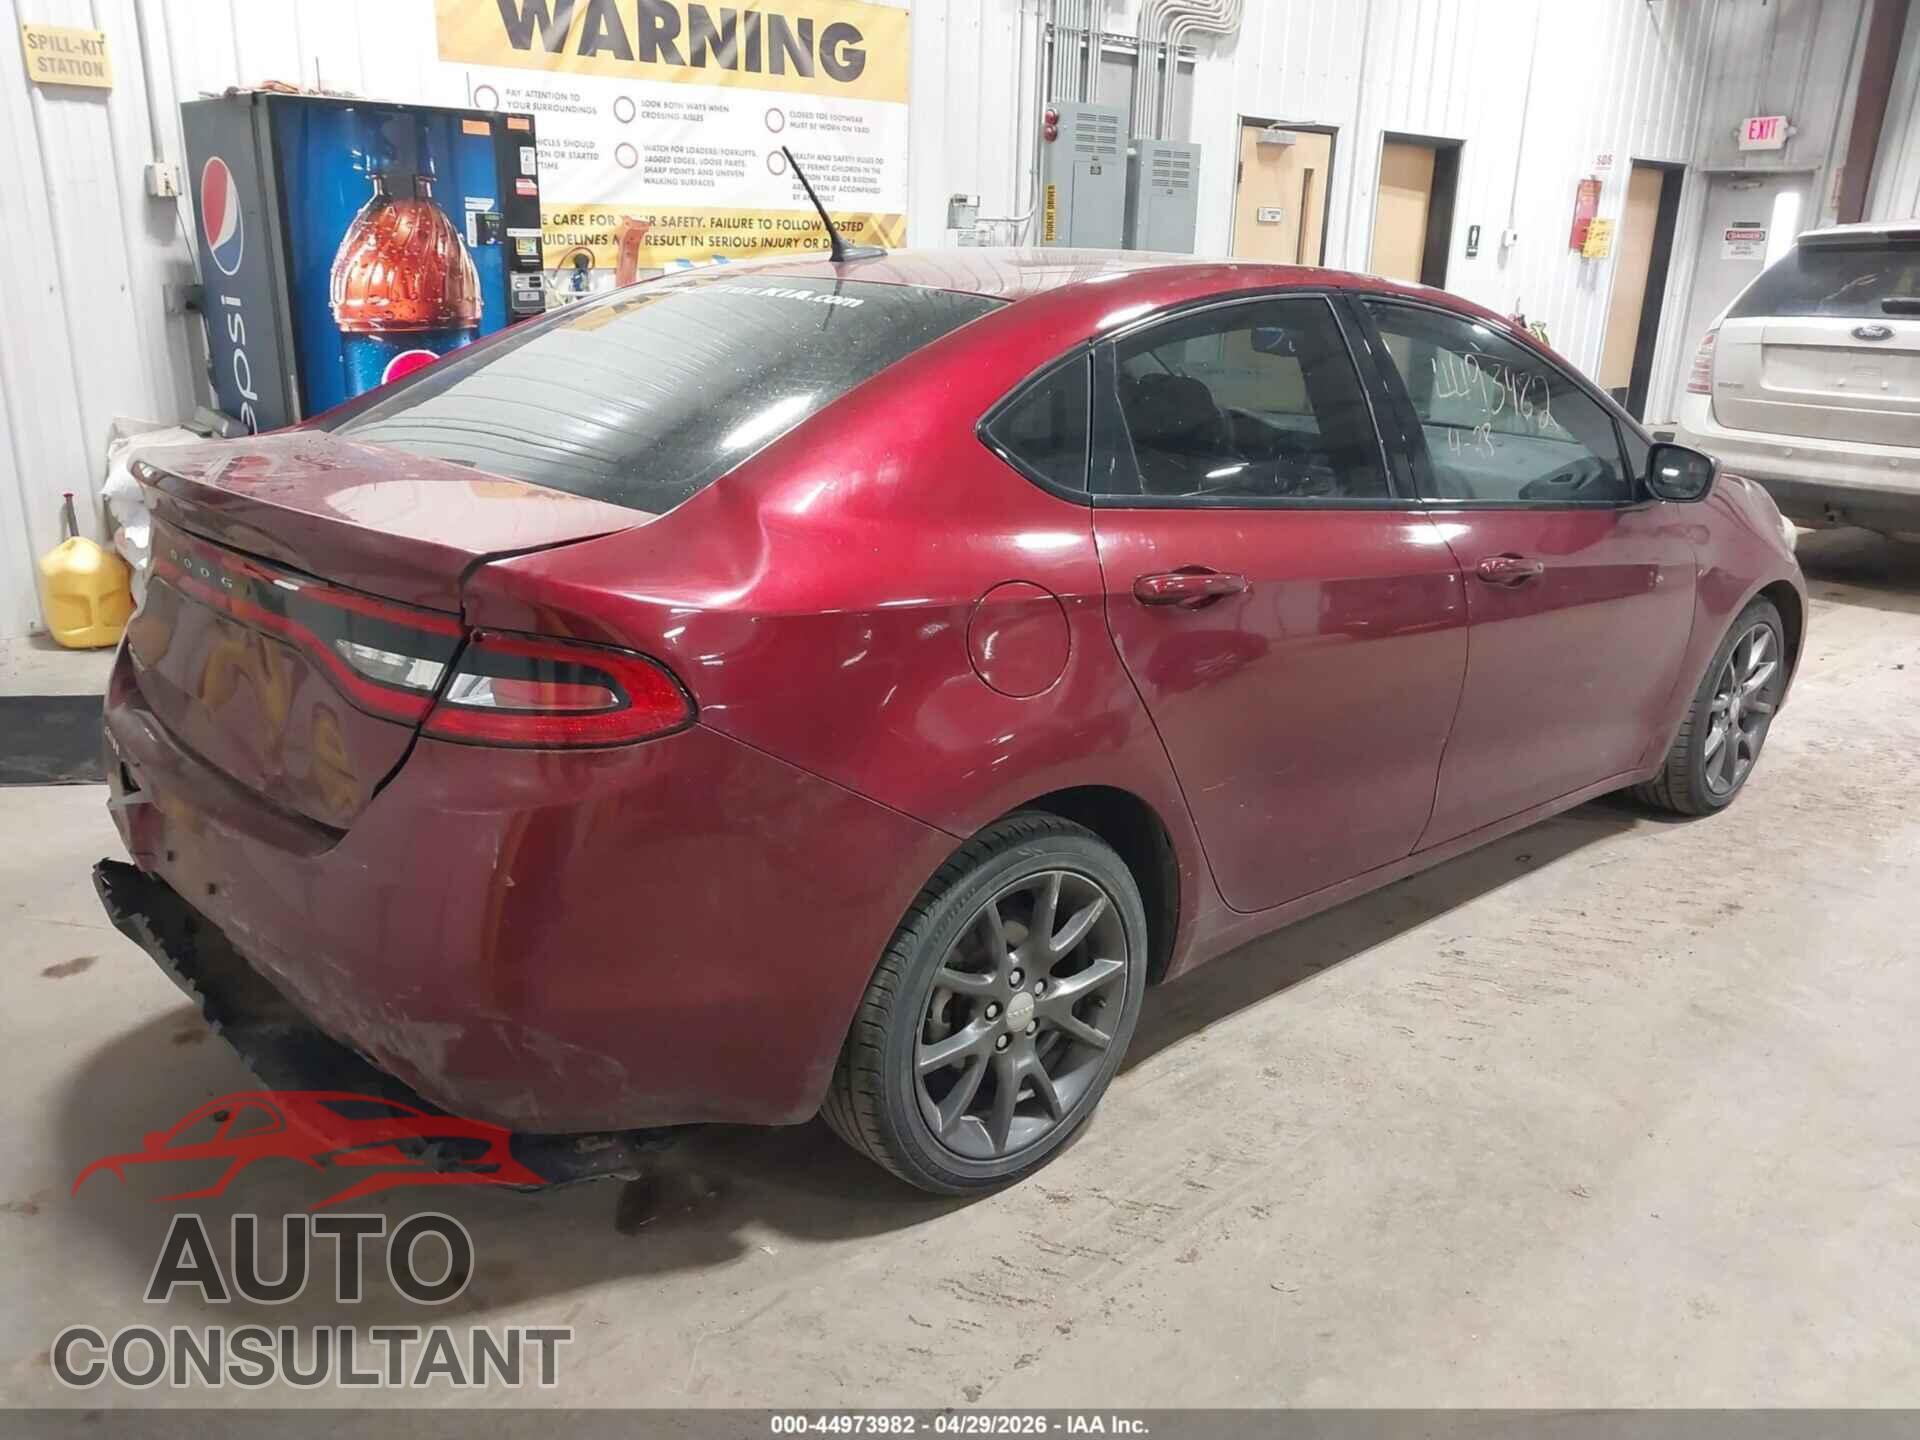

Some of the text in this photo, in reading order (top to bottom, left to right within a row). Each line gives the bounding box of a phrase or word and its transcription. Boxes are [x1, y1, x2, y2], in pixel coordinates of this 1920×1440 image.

[27, 32, 105, 56] SPILL-KIT
[499, 0, 867, 82] WARNING
[38, 56, 105, 77] STATION
[526, 90, 568, 101] ATTENTION
[570, 94, 580, 102] TO
[507, 101, 598, 115] YOUR SURROUNDINGS
[641, 99, 661, 108] LOOK
[708, 104, 730, 113] WHEN
[641, 111, 680, 120] CROSSING
[1748, 118, 1779, 141] EXIT
[563, 139, 596, 149] SHOULD
[670, 145, 684, 153] FOR
[554, 151, 566, 160] OR
[568, 152, 600, 161] STARTED
[669, 167, 695, 176] POINTS
[697, 168, 714, 177] AND
[643, 177, 716, 188] WALKING SURFACES
[553, 214, 584, 226] CARE
[590, 214, 616, 226] FOR
[661, 216, 706, 228] SAFETY.
[710, 217, 753, 230] FAILURE
[758, 219, 772, 230] TO
[776, 219, 822, 231] FOLLOW
[542, 234, 608, 246] UIDELINES
[645, 235, 686, 247] RESULT
[691, 235, 704, 247] IN
[709, 236, 757, 248] SERIOUS
[760, 237, 800, 249] INJURY
[803, 237, 819, 249] OR
[220, 295, 258, 436] epsi
